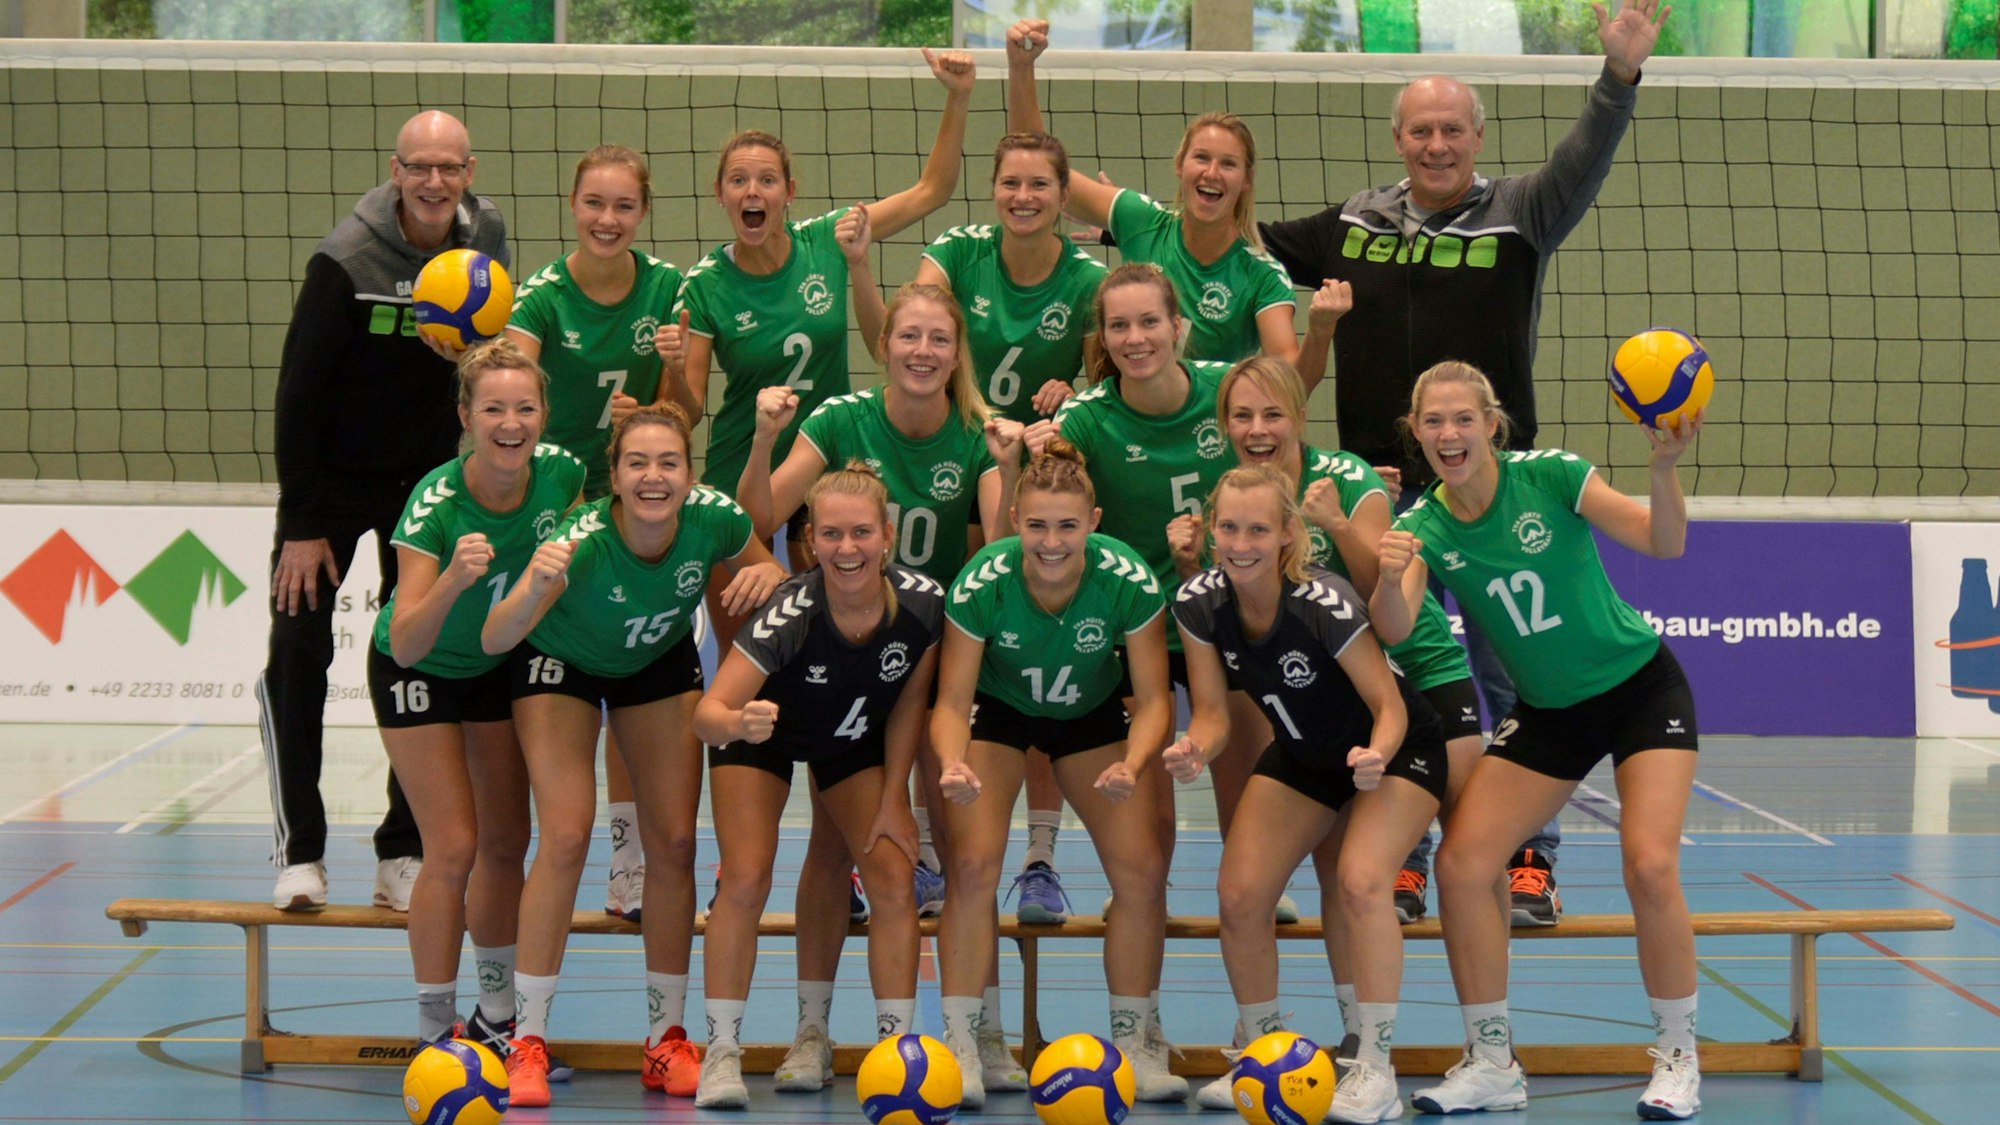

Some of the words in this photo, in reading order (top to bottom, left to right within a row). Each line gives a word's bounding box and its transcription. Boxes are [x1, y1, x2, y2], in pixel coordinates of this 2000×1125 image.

[783, 332, 813, 391] 2
[988, 346, 1024, 406] 6
[597, 370, 628, 429] 7
[1170, 472, 1201, 516] 5
[1487, 570, 1562, 636] 12
[624, 606, 680, 648] 15
[1638, 611, 1881, 643] bau-gmbh.de
[88, 682, 122, 697] +49
[128, 682, 173, 697] 2233
[180, 682, 223, 698] 8081
[231, 683, 244, 698] 0
[528, 655, 564, 685] 15
[1021, 665, 1081, 706] 14
[390, 680, 430, 714] 16
[834, 697, 868, 740] 4
[1262, 694, 1303, 739] 1
